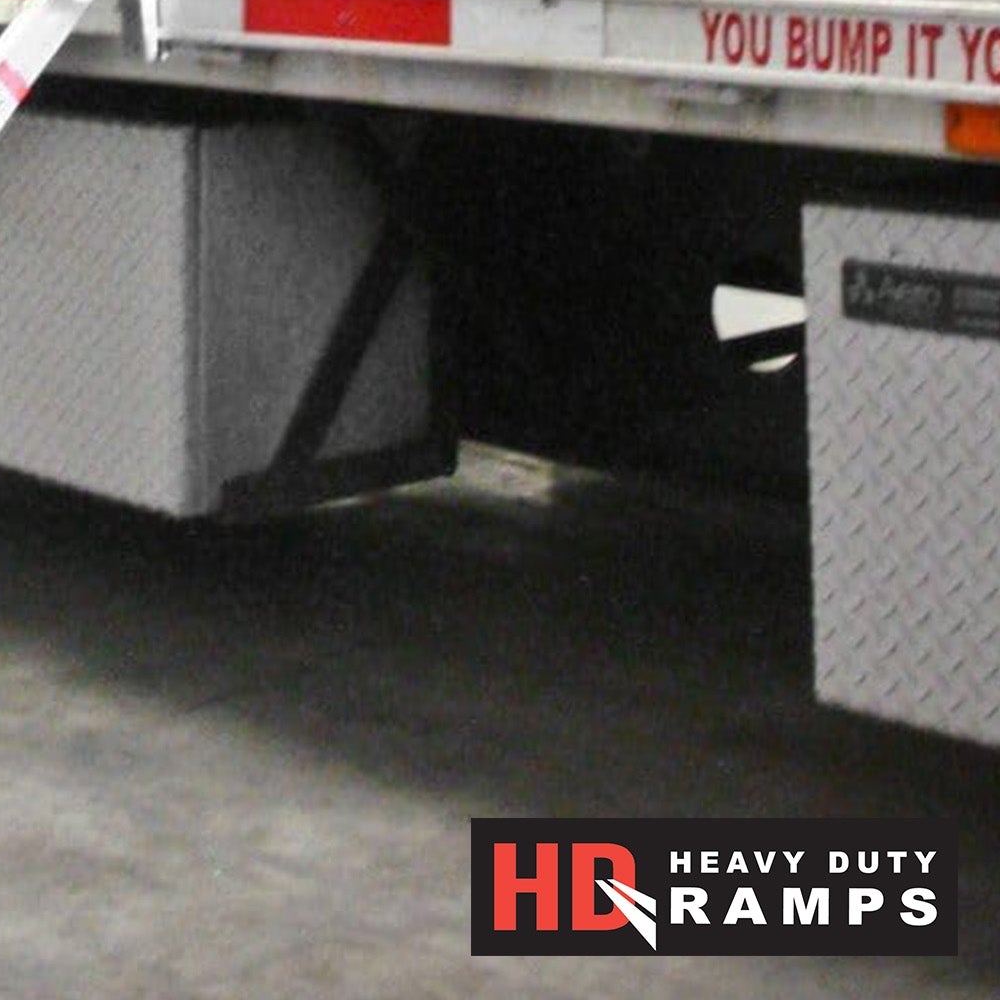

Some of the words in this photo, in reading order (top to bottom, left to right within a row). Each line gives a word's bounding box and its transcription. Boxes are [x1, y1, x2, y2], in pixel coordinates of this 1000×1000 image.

[701, 10, 771, 66] YOU
[787, 15, 892, 75] BUMP
[908, 22, 944, 79] IT
